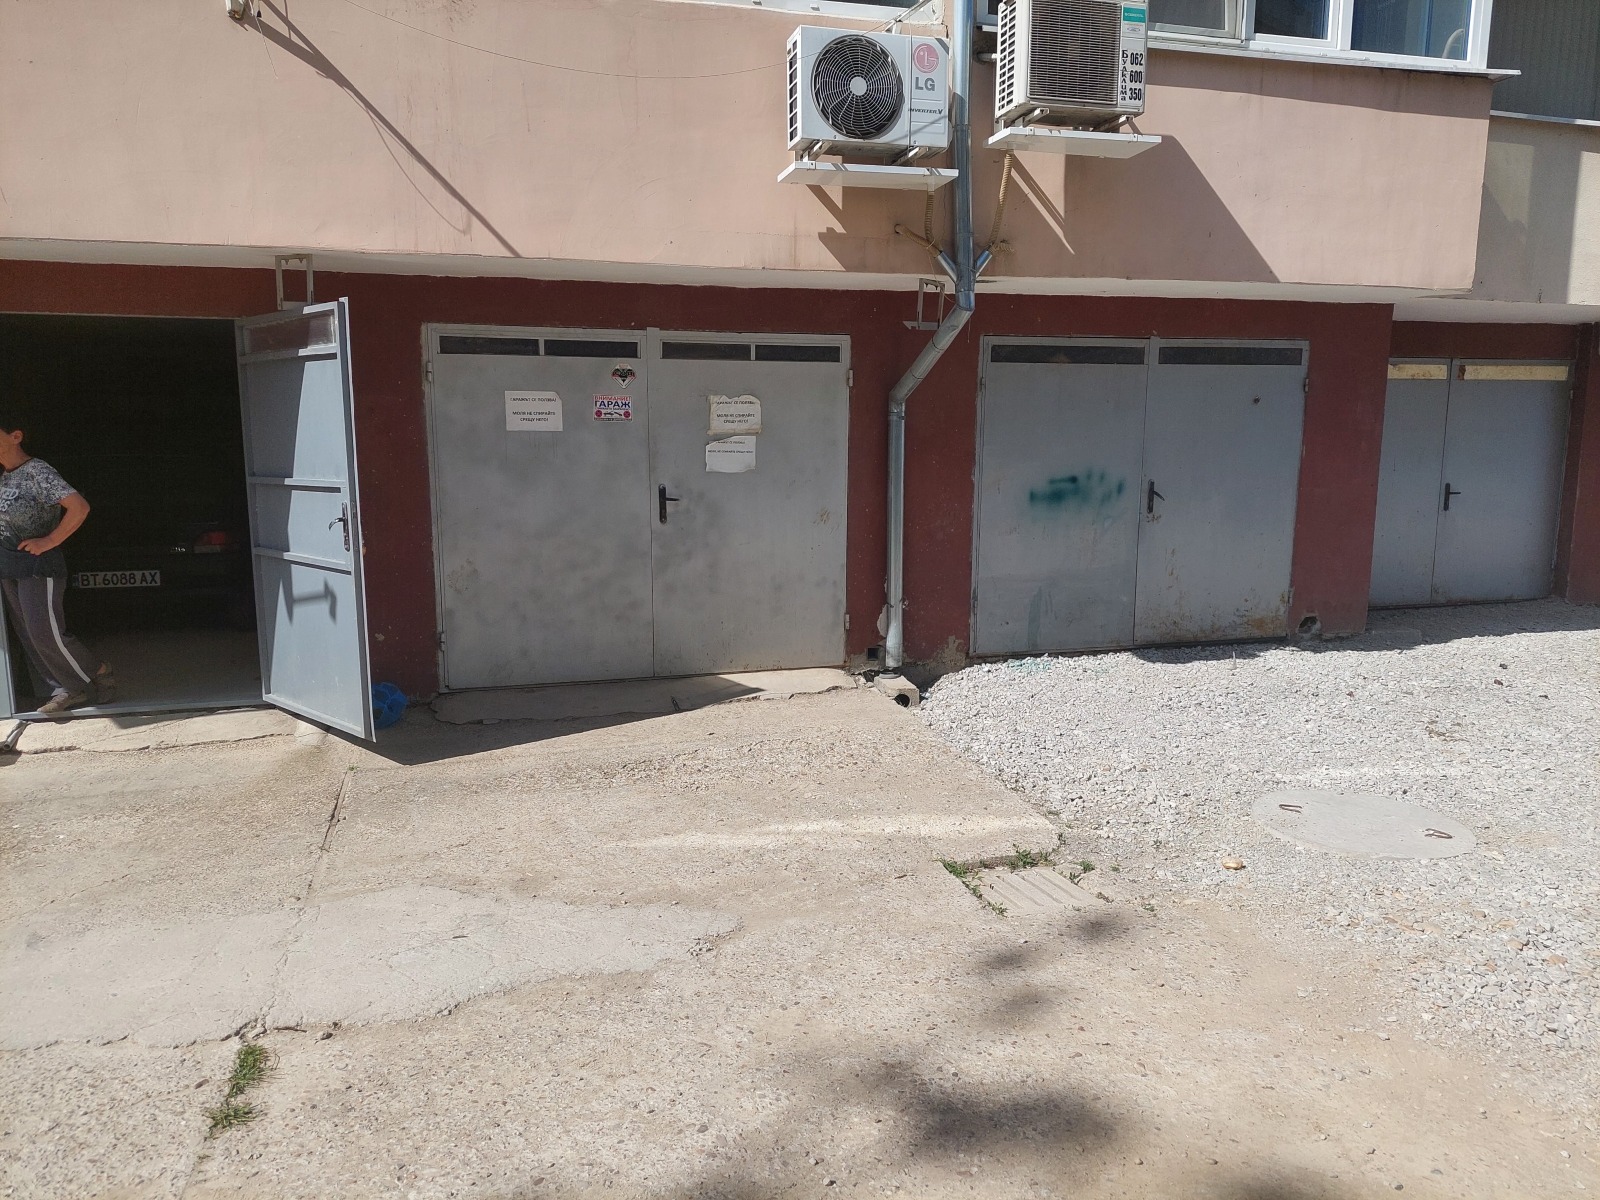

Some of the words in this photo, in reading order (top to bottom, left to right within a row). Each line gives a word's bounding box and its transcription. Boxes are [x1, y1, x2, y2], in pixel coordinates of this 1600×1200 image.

[1130, 52, 1144, 66] 062
[915, 76, 935, 91] LG
[1129, 70, 1143, 83] 600
[1128, 87, 1142, 101] 350
[594, 400, 631, 408] ГАРАЖ
[81, 573, 99, 587] BT
[102, 572, 137, 586] 6088
[140, 571, 158, 585] AX
